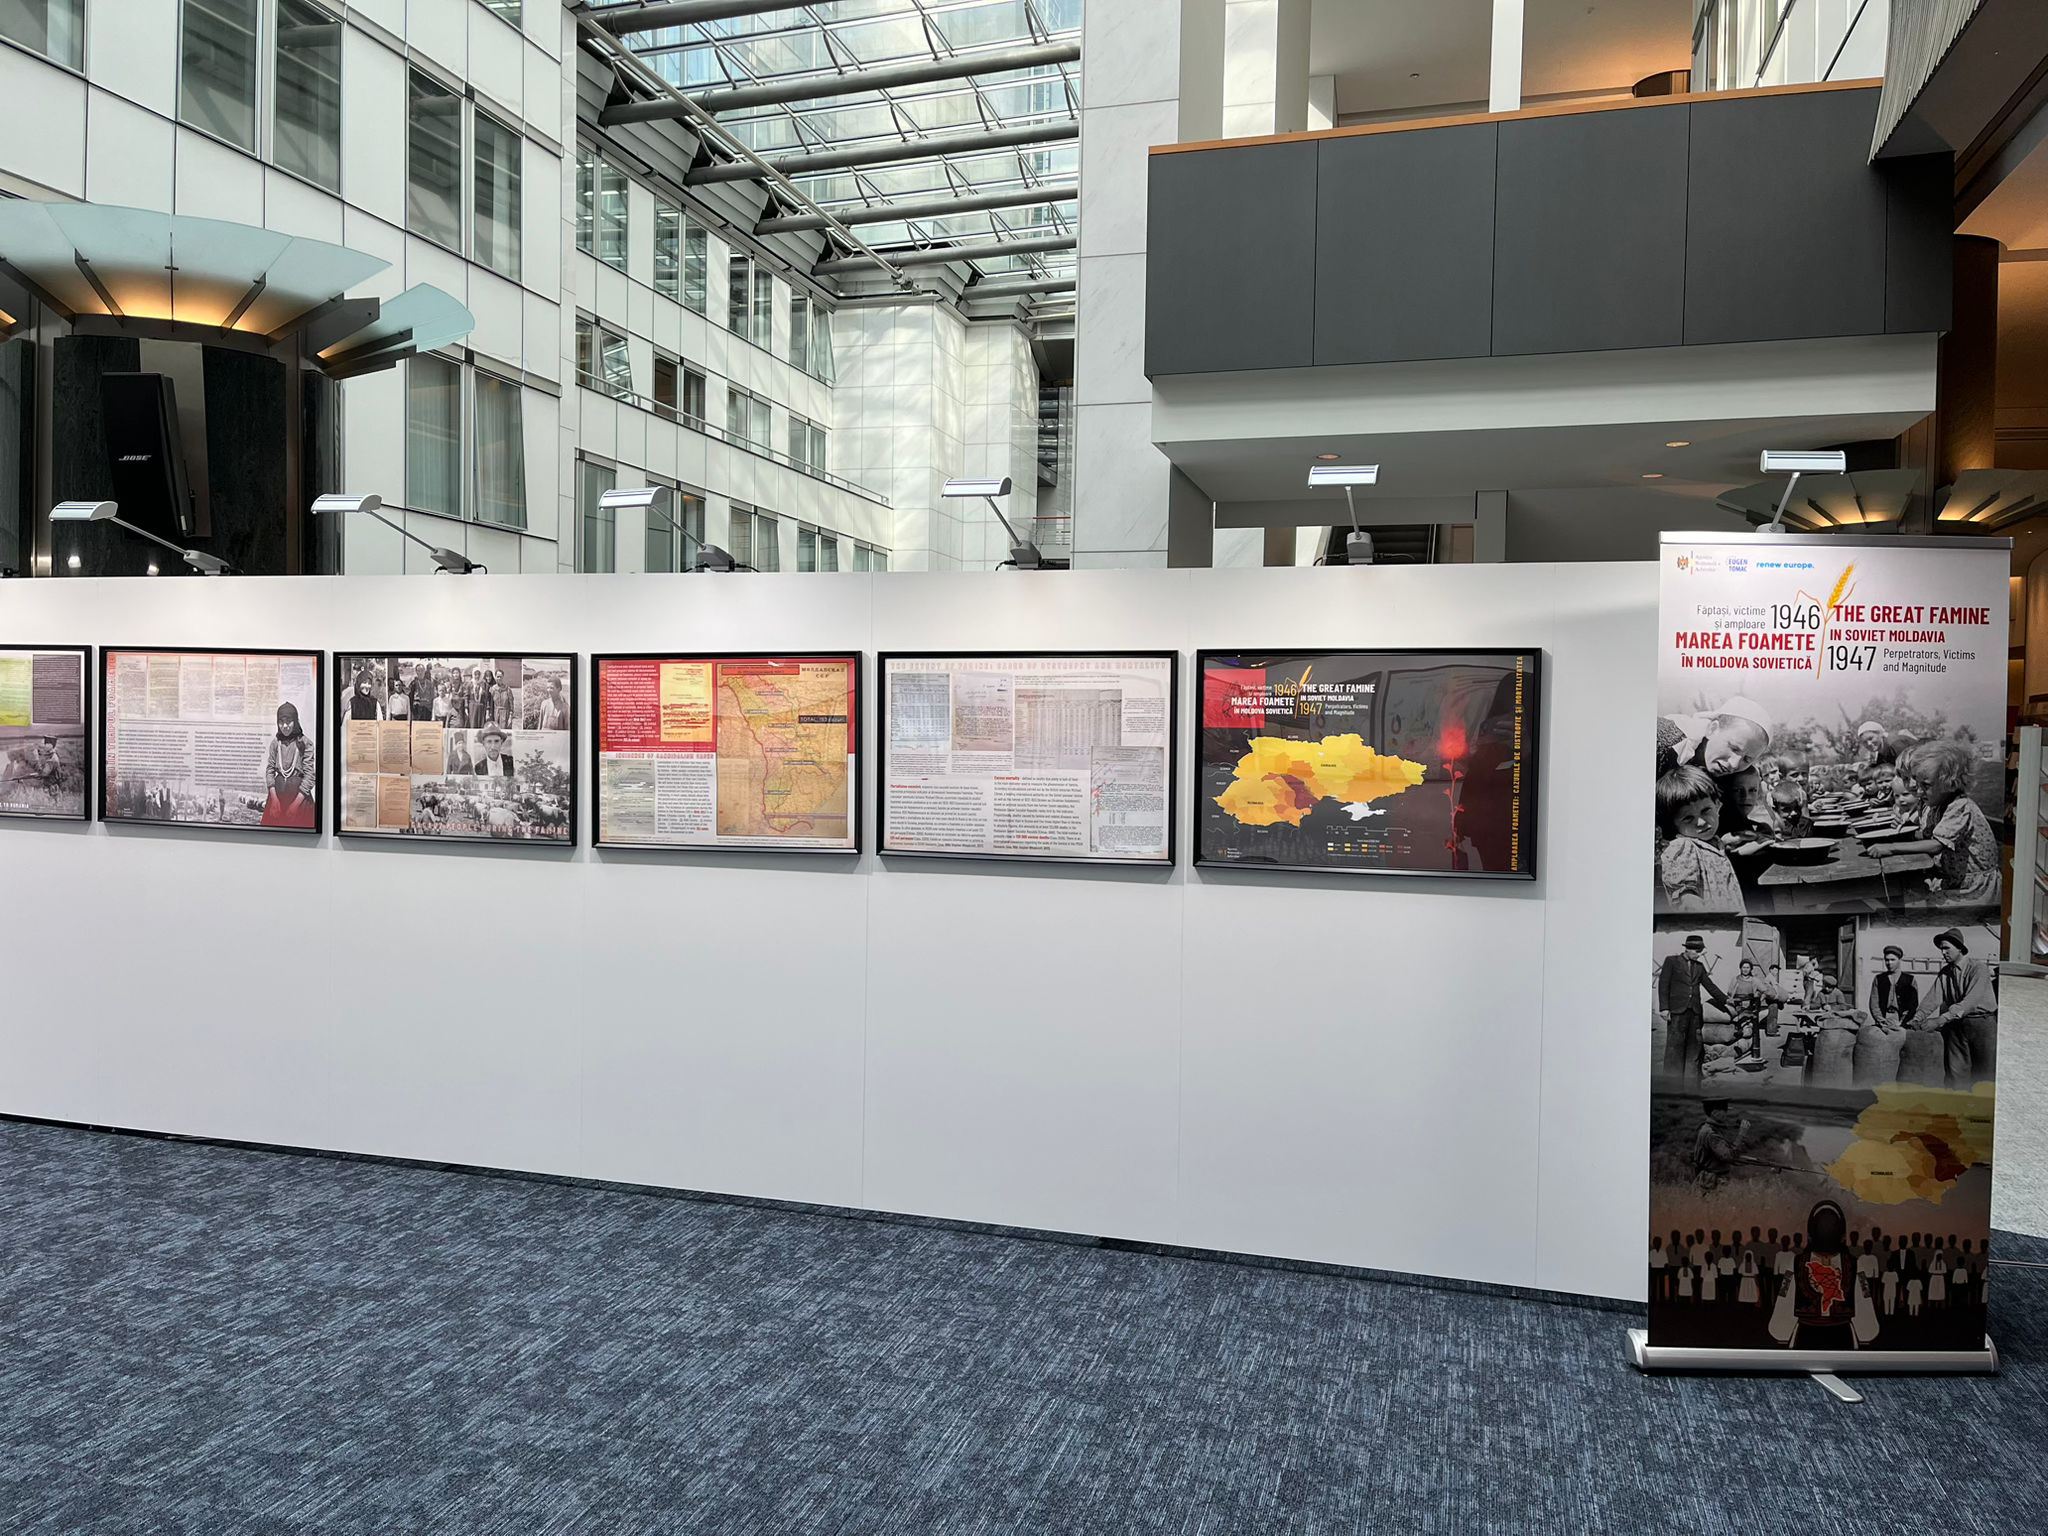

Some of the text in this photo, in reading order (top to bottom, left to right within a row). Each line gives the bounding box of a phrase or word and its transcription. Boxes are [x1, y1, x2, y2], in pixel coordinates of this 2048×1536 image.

[1734, 605, 1766, 616] victime
[1770, 604, 1820, 630] 1946
[1833, 604, 1991, 625] THE GREAT FAMINE
[1724, 619, 1766, 631] amploare
[1675, 631, 1816, 651] MAREA FOAMETE
[1830, 629, 1945, 643] IN SOVIET MOLDAVIA
[1827, 645, 1877, 671] 1947
[1883, 648, 1976, 660] Perpetrators, Victims
[1681, 652, 1812, 670] ÎN MOLDOVA SOVIETICĂ
[1883, 662, 1947, 675] and Magnitude
[1515, 656, 1523, 704] MORTALITATEA
[1274, 683, 1297, 696] 1946
[1303, 683, 1376, 693] THE GREAT FAMINE
[1231, 697, 1295, 706] MAREA FOAMETE
[1300, 702, 1323, 715] 1947
[1514, 752, 1521, 760] DE
[480, 824, 513, 833] DURING
[535, 826, 568, 835] FAMINE
[1510, 833, 1518, 871] AMPLOAREA
